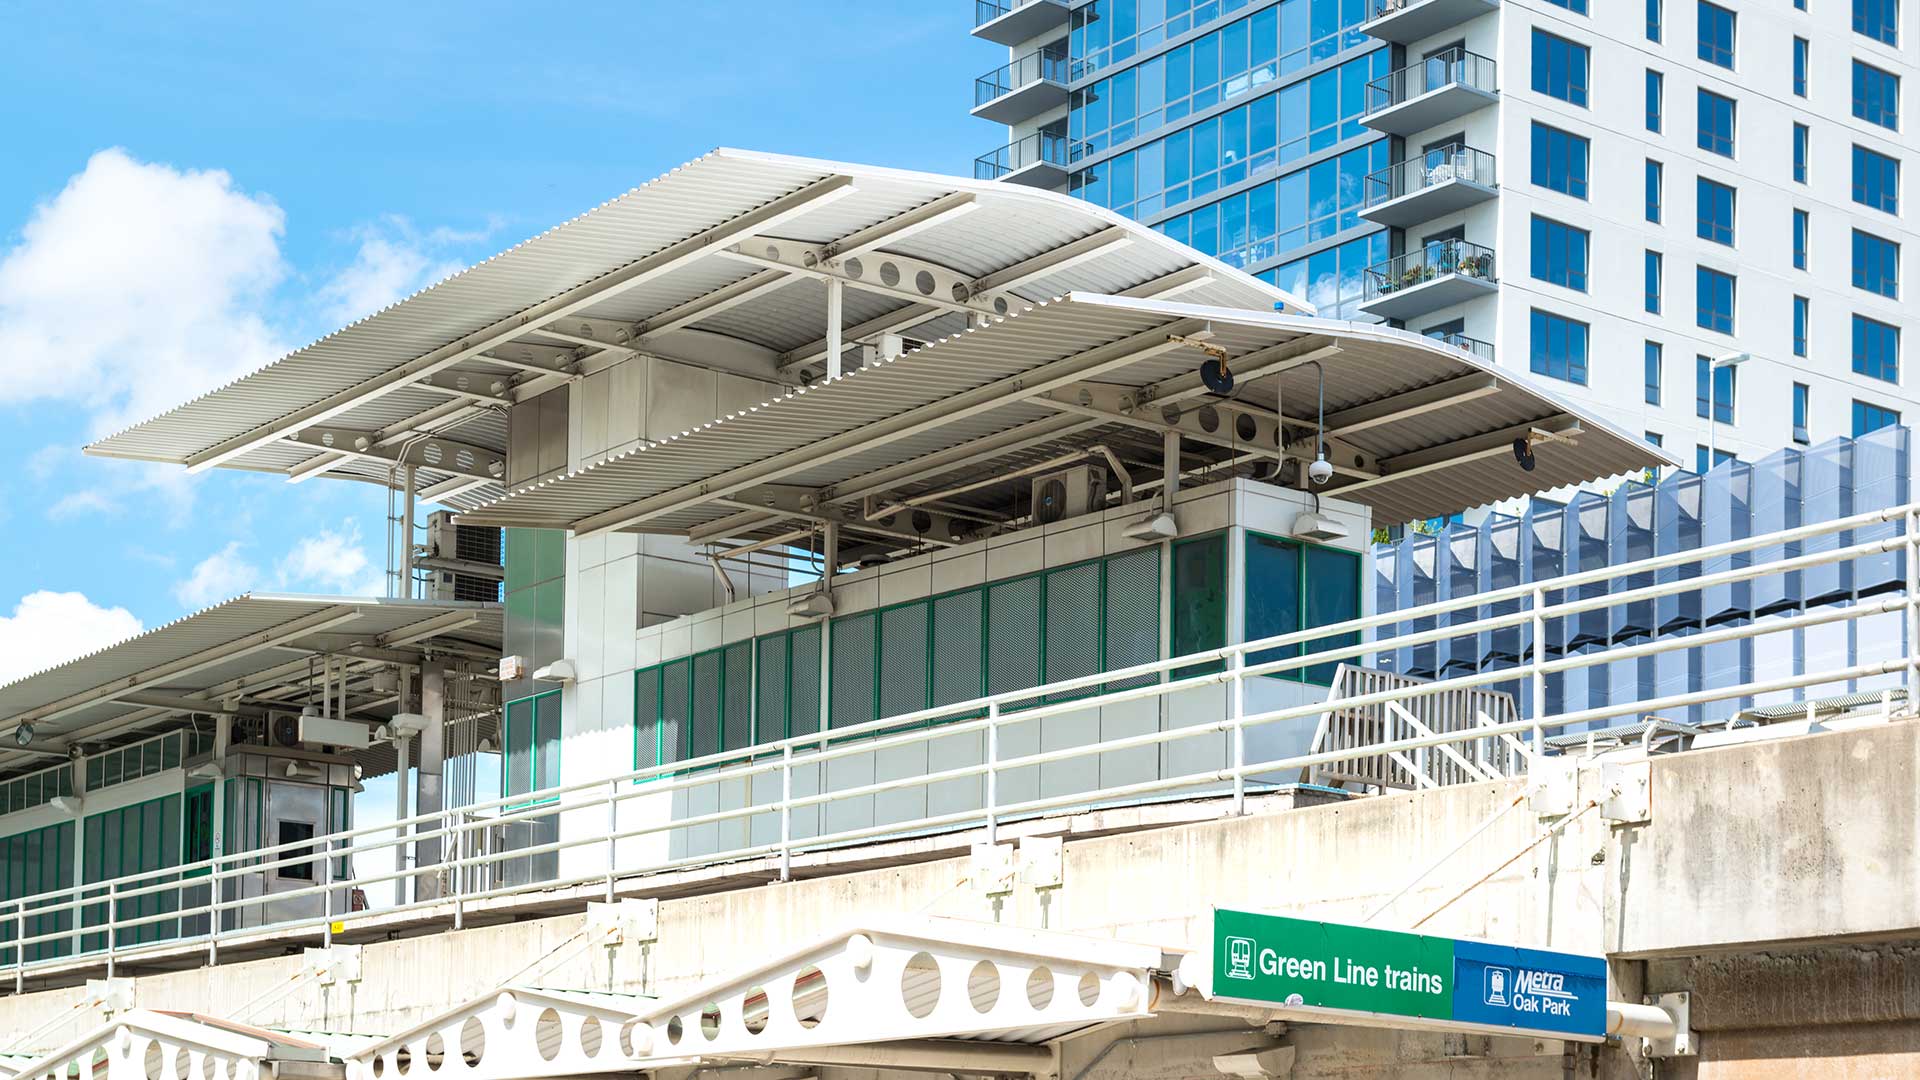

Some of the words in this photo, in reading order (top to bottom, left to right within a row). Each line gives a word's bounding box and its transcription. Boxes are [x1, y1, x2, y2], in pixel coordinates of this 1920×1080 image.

[1259, 948, 1326, 981] Green
[1334, 957, 1378, 987] Line
[1384, 965, 1443, 994] trains
[1514, 970, 1565, 994] Metra
[1513, 993, 1539, 1013] Oak
[1542, 997, 1571, 1017] Park
